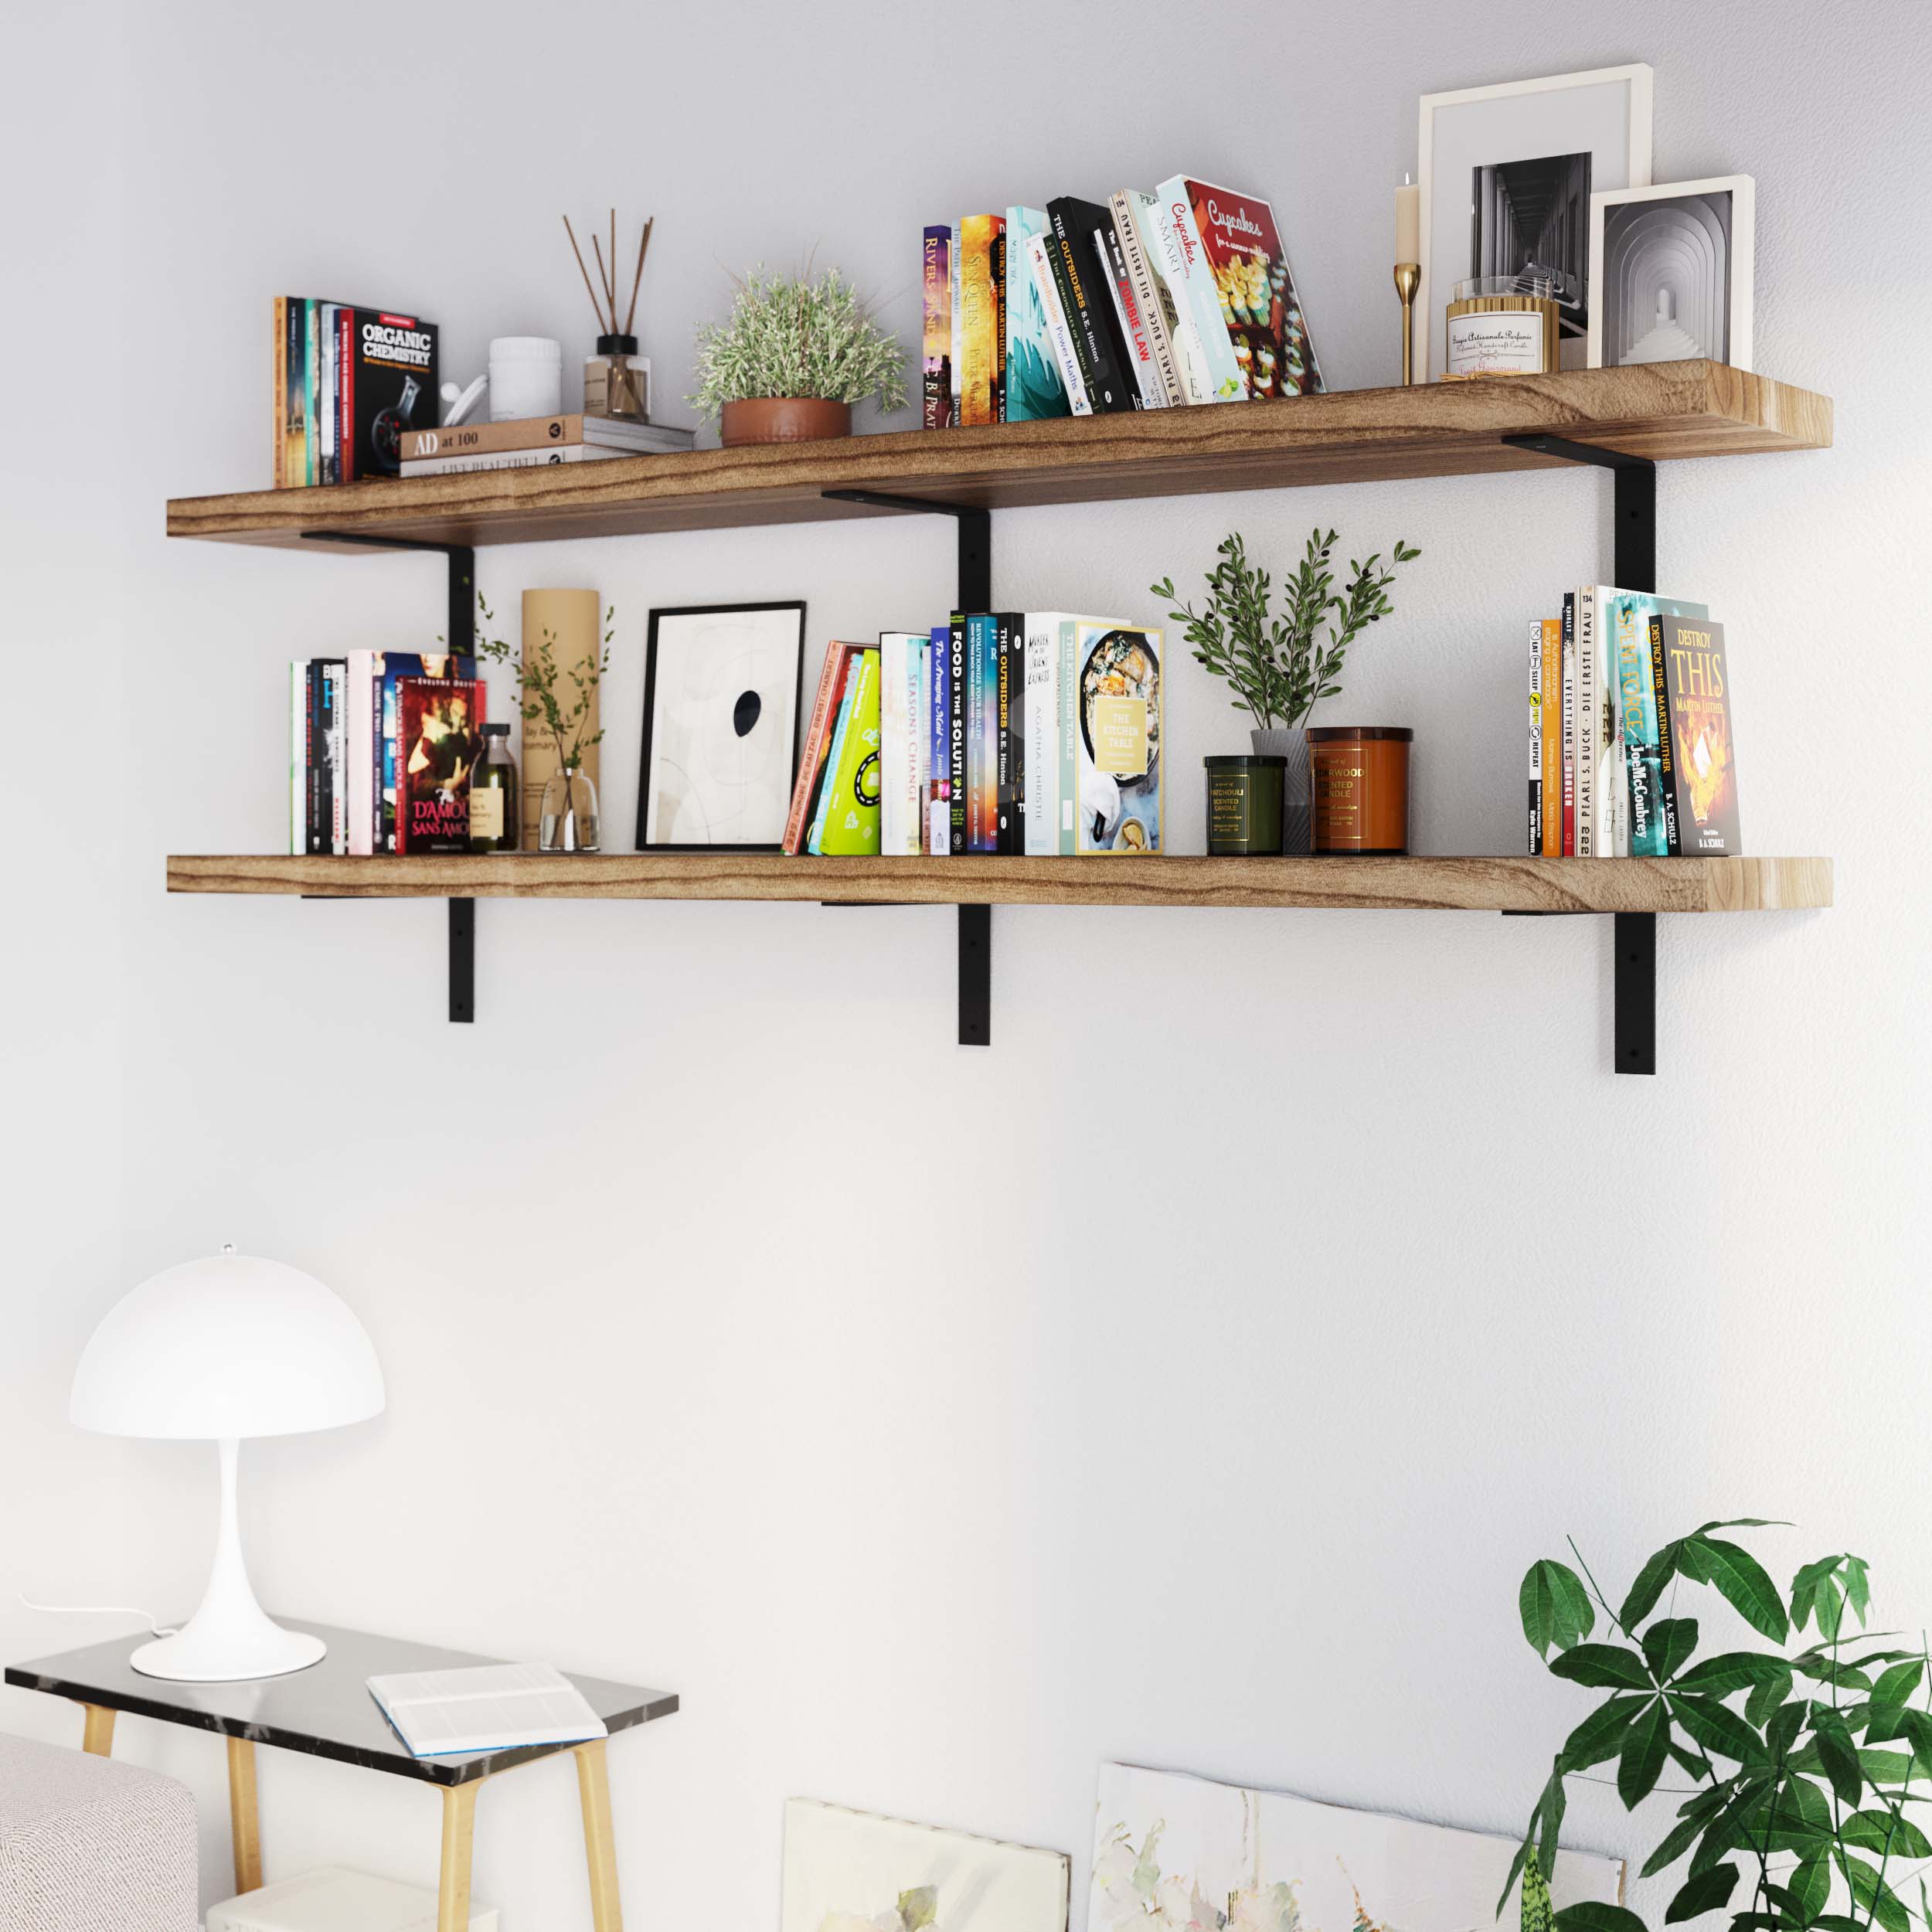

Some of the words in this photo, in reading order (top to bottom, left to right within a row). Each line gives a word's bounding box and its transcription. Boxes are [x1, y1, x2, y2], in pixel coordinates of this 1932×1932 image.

[1121, 215, 1134, 242] FRAU
[1172, 202, 1195, 265] Cupcakes
[1208, 199, 1263, 236] Cupcakes
[926, 236, 938, 290] RIVERS
[1129, 243, 1148, 277] ERSTE
[1053, 214, 1065, 240] THE
[1060, 240, 1086, 309] OUTSIDERS
[1081, 311, 1091, 332] S.E.
[1086, 331, 1099, 363] Hinton
[1139, 280, 1149, 299] DIE
[362, 324, 431, 350] ORGANIC
[1058, 276, 1077, 330] CHRONICLES
[1075, 340, 1087, 371] NARNIA
[1117, 280, 1141, 330] ZOMBIE
[1133, 329, 1151, 363] LAW
[1148, 311, 1162, 338] BUCK
[363, 342, 430, 366] CHEMISTRY
[1056, 325, 1068, 355] Power
[1065, 355, 1078, 390] Maths
[1158, 342, 1165, 355] S.
[1160, 355, 1177, 388] PEARL
[414, 433, 438, 456] AD
[442, 436, 455, 448] at
[457, 432, 478, 446] 100
[1582, 594, 1594, 603] 134
[1583, 613, 1591, 645] FRAU
[1617, 609, 1634, 664] SPENT
[1651, 624, 1662, 664] DESTROY
[1678, 629, 1711, 648] DESTROY
[936, 641, 944, 657] The
[952, 631, 962, 678] FOOD
[1066, 633, 1074, 660] THE
[934, 659, 944, 708] Avenging
[954, 682, 961, 690] IS
[1583, 651, 1591, 689] ERSTE
[1655, 665, 1665, 689] THIS
[1671, 648, 1724, 698] THIS
[1066, 662, 1074, 719] KITCHEN
[1583, 693, 1591, 713] DIE
[1621, 672, 1644, 730] FORCE
[1676, 699, 1701, 713] MARTIN
[1702, 700, 1724, 714] LUTHER
[934, 709, 944, 736] Maid
[1103, 724, 1138, 736] KITCHEN
[1113, 713, 1131, 724] THE
[1657, 695, 1668, 735] MARTIN
[1066, 721, 1074, 760] TABLE
[1108, 737, 1134, 749] TABLE
[1565, 750, 1573, 760] IS
[1583, 728, 1591, 761] BUCK
[1661, 735, 1671, 773] LUTHER
[909, 742, 918, 804] CHANGE
[1564, 766, 1573, 807] BROKEN
[1583, 765, 1590, 775] S.
[1034, 765, 1043, 822] CHRISTIE
[1582, 779, 1591, 818] PEARL
[412, 821, 440, 836] SANS
[1667, 814, 1677, 845] SCHULZ
